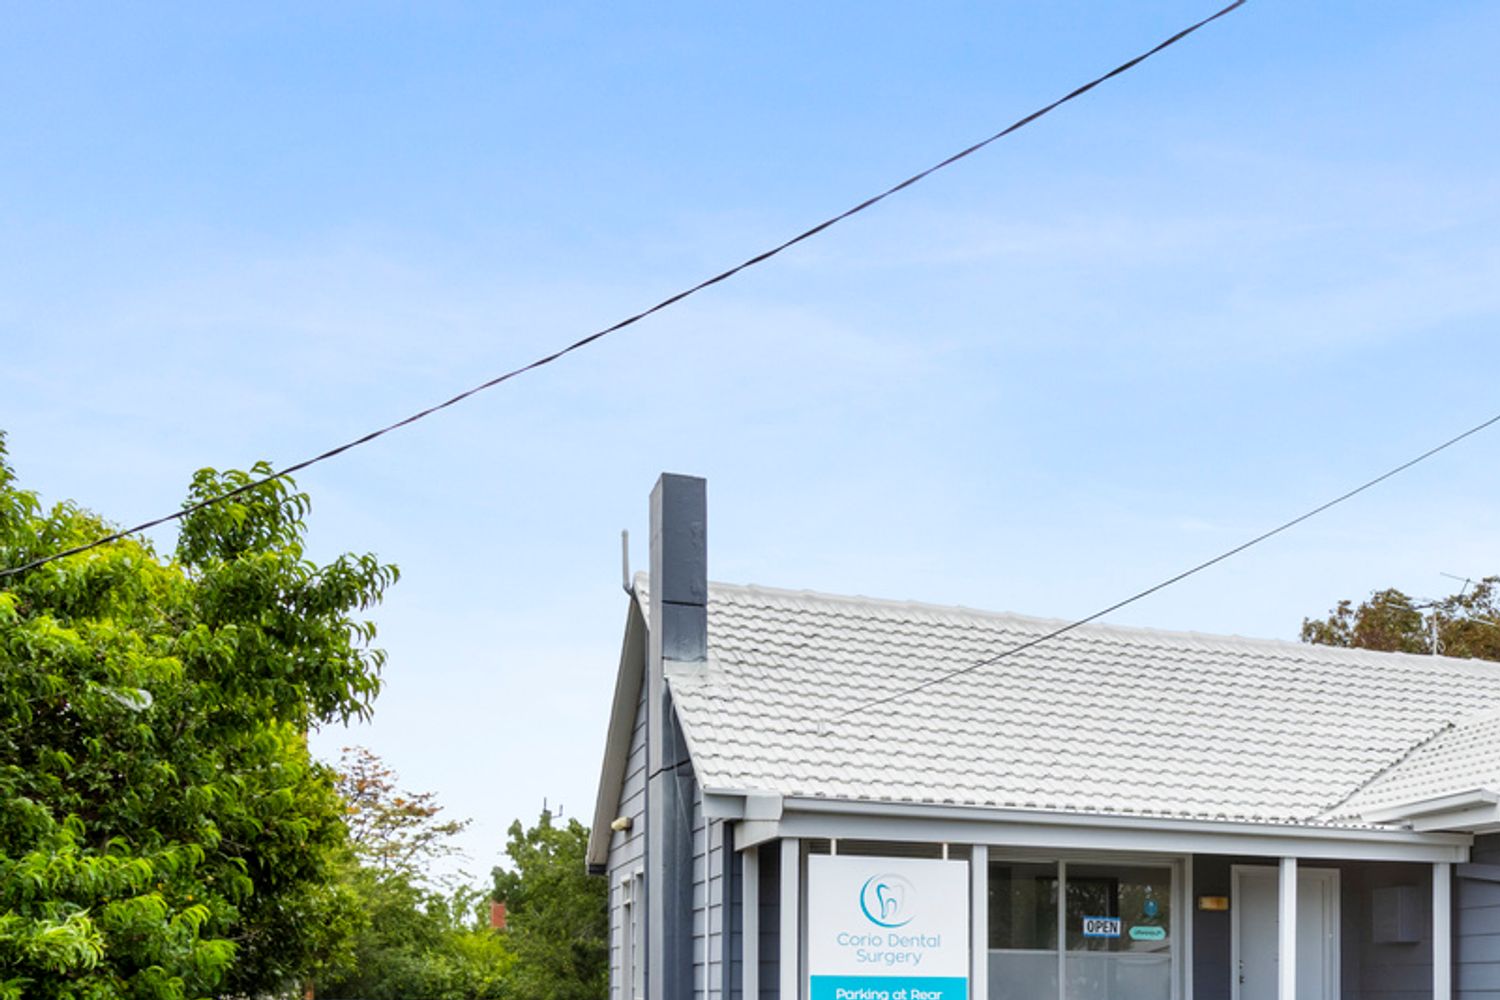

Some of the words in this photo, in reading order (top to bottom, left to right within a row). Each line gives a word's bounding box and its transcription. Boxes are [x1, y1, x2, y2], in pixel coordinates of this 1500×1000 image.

[1087, 920, 1118, 933] OPEN
[836, 932, 883, 947] Corio
[887, 933, 941, 948] Dental
[855, 948, 922, 966] Surgery
[892, 988, 908, 1000] at
[910, 988, 943, 1000] Rear
